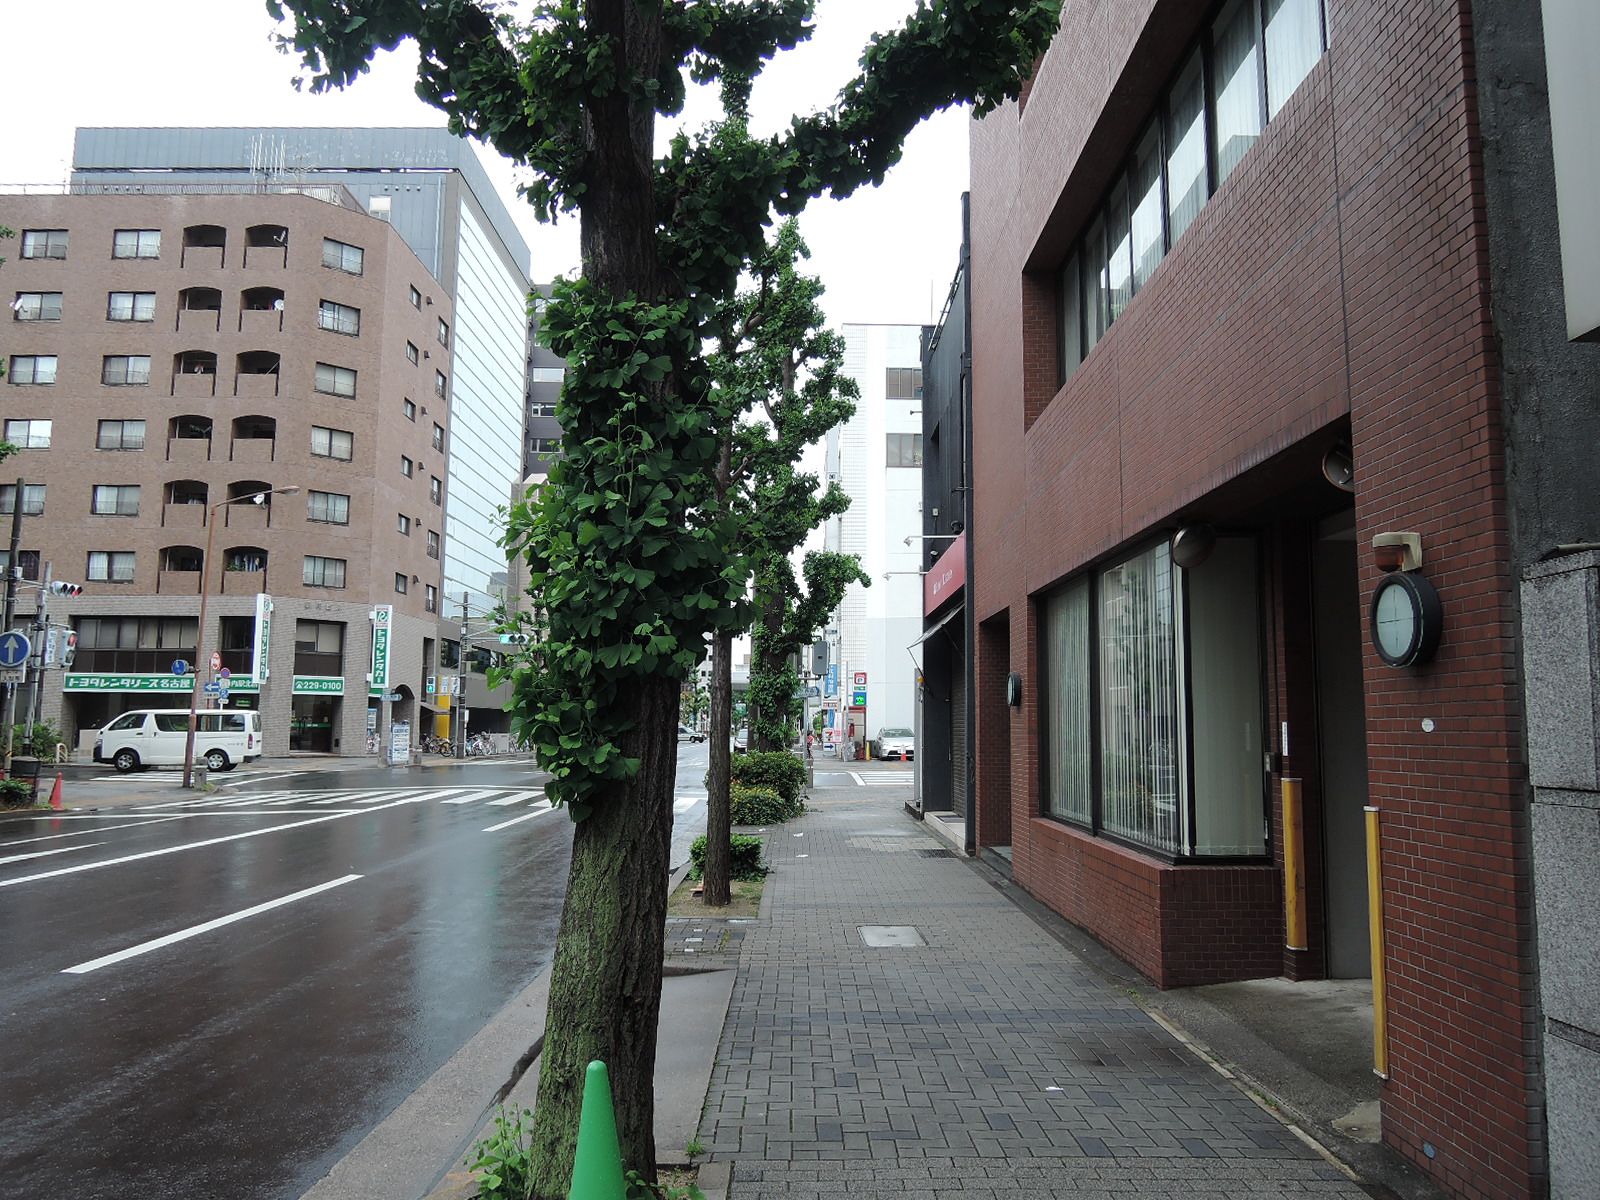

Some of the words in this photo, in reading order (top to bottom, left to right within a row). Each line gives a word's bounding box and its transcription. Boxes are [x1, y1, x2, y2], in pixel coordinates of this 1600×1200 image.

[376, 629, 386, 683] トヨタレンタカー
